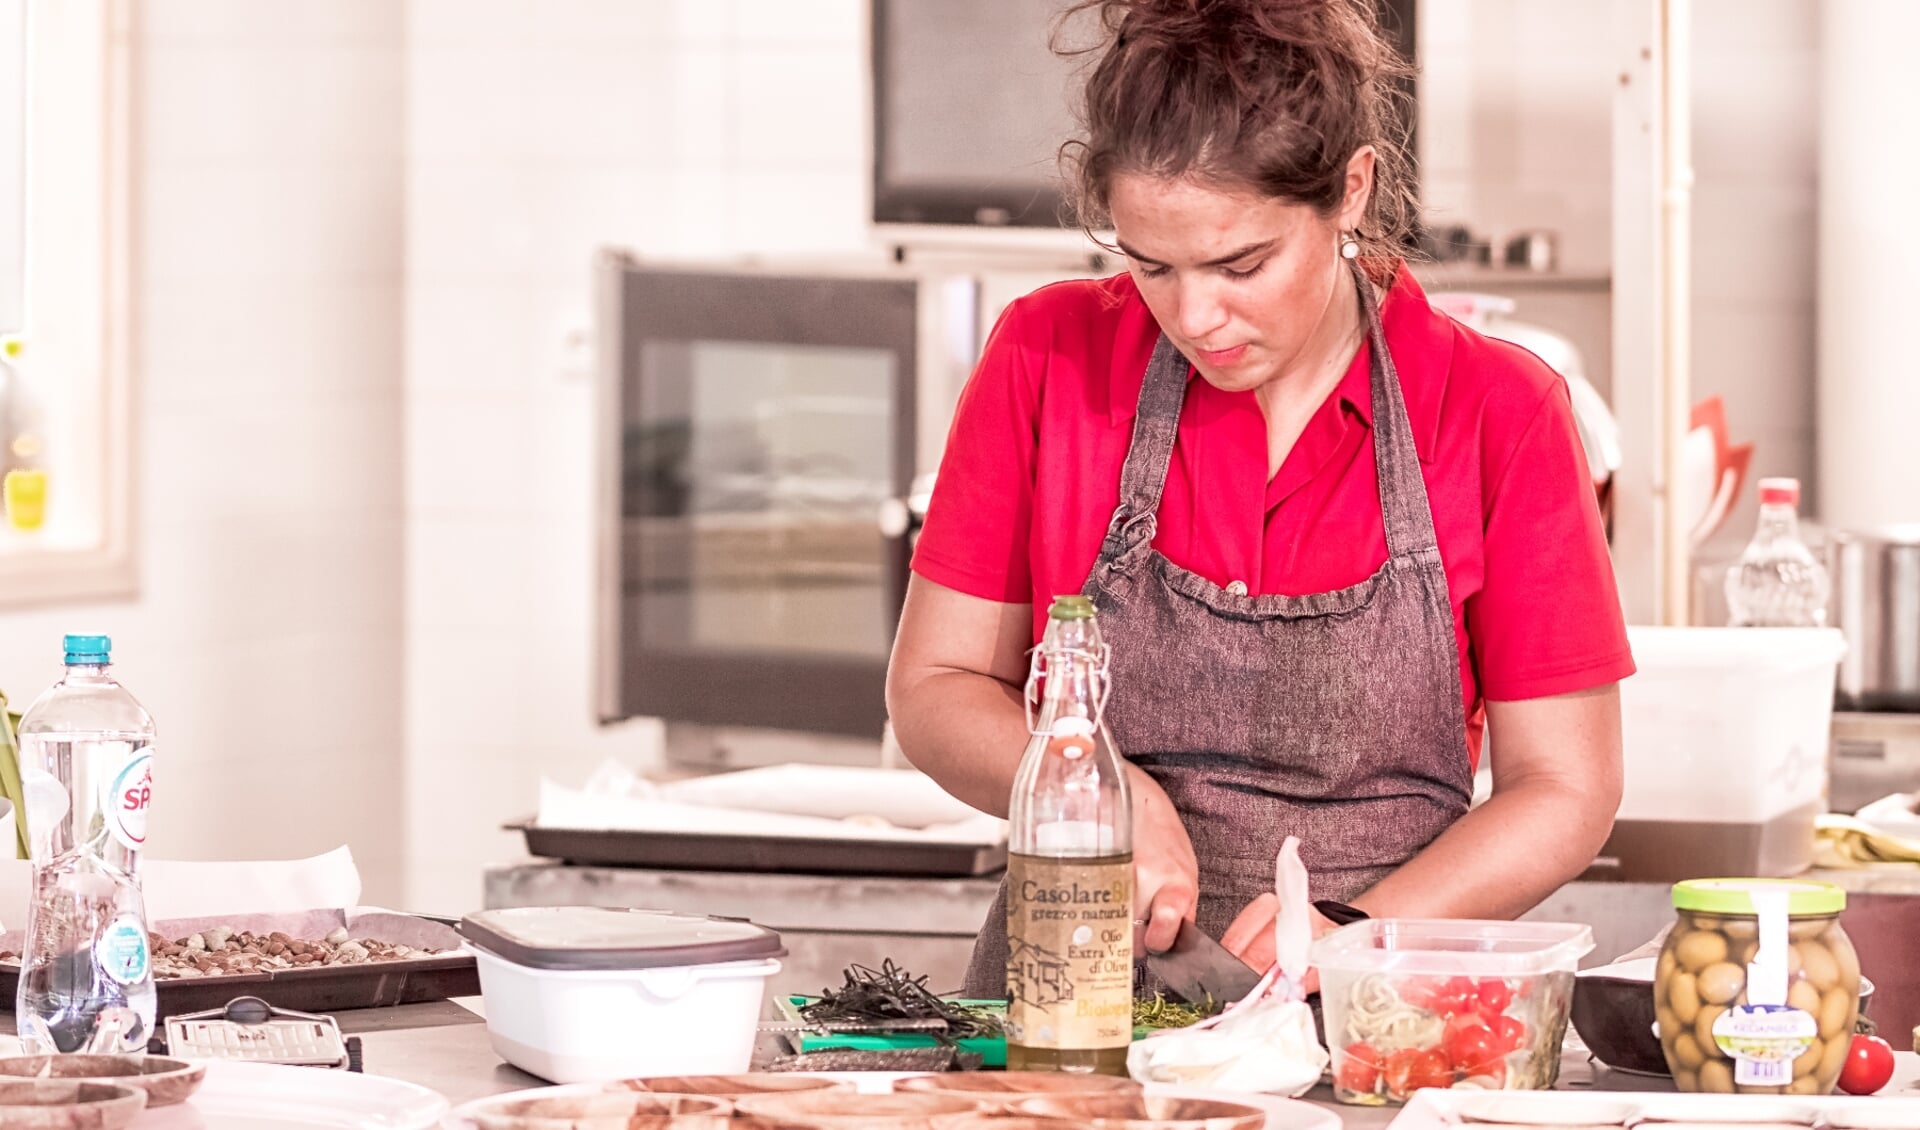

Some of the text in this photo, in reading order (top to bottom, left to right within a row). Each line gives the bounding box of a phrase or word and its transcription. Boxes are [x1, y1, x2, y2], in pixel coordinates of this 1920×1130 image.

[1031, 904, 1128, 921] grezzo naturale
[1101, 928, 1122, 943] Olio
[1068, 945, 1104, 958] Extra
[1089, 961, 1100, 974] di
